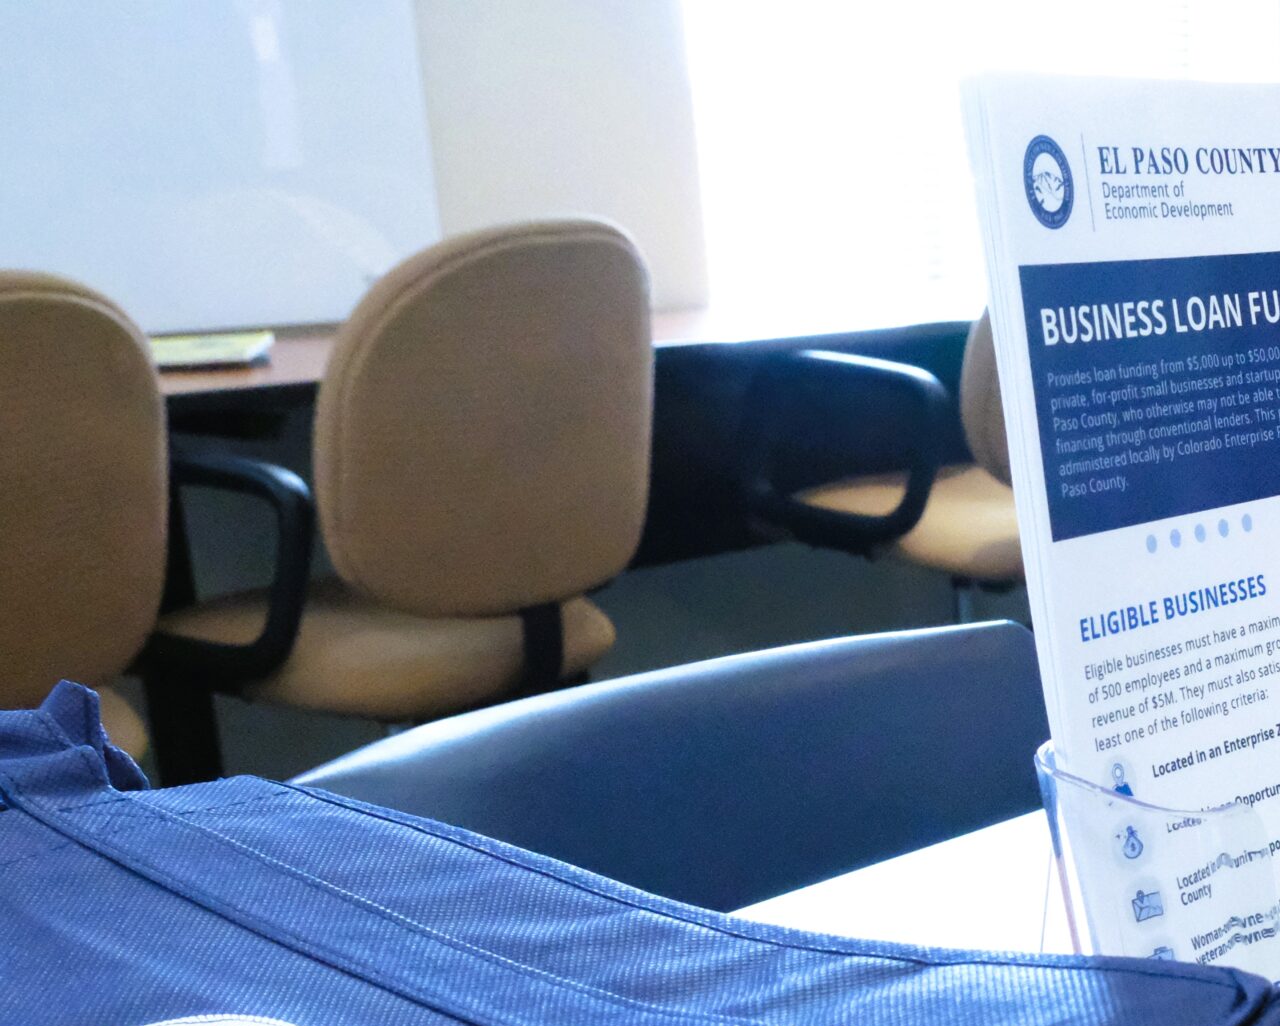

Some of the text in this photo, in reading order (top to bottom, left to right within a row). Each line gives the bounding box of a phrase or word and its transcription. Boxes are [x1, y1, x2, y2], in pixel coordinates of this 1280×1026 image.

[1097, 146, 1280, 174] EL PASO COUNTY
[1101, 180, 1184, 201] Department of
[1104, 200, 1233, 219] Economic Development
[1040, 299, 1167, 345] BUSINESS
[1172, 293, 1242, 332] LOAN
[1047, 369, 1092, 387] Provides
[1093, 366, 1116, 382] loan
[1118, 362, 1159, 379] funding
[1160, 358, 1184, 374] from
[1186, 353, 1219, 371] $5,000
[1221, 355, 1233, 368] up
[1235, 353, 1245, 364] to
[1051, 393, 1089, 412] private,
[1091, 384, 1139, 405] for-profit
[1140, 379, 1168, 398] small
[1169, 376, 1223, 394] businesses
[1226, 370, 1243, 386] and
[1052, 416, 1078, 432] Paso
[1080, 411, 1120, 428] County,
[1122, 406, 1143, 421] who
[1145, 399, 1194, 419] otherwise
[1197, 397, 1217, 413] may
[1220, 394, 1236, 407] not
[1237, 391, 1250, 404] be
[1253, 387, 1273, 402] able
[1056, 435, 1105, 454] financing
[1105, 426, 1146, 447] through
[1148, 415, 1212, 439] conventional
[1213, 412, 1253, 428] lenders.
[1254, 407, 1275, 422] This
[1059, 451, 1127, 476] administered
[1128, 445, 1160, 464] locally
[1162, 444, 1174, 462] by
[1177, 436, 1222, 455] Colorado
[1224, 429, 1274, 447] Enterprise
[1061, 475, 1128, 497] Paso County.
[1080, 574, 1266, 642] ELIGIBLE BUSINESSES
[1084, 657, 1123, 680] Eligible
[1125, 643, 1182, 668] businesses
[1185, 634, 1211, 651] must
[1212, 628, 1237, 643] have
[1240, 626, 1246, 636] a
[1088, 687, 1098, 704] of
[1101, 681, 1122, 700] 500
[1124, 667, 1180, 693] employees
[1183, 658, 1203, 676] and
[1205, 658, 1212, 670] a
[1214, 644, 1263, 666] maximum
[1092, 705, 1135, 728] revenue
[1138, 696, 1148, 713] of
[1151, 690, 1177, 709] $5M.
[1179, 684, 1204, 700] They
[1207, 675, 1233, 692] must
[1235, 669, 1256, 684] also
[1094, 688, 1268, 752] least one of the following criteria:
[1152, 751, 1194, 778] Located
[1195, 750, 1206, 763] in
[1209, 746, 1222, 759] an
[1223, 729, 1274, 753] Enterprise
[1180, 883, 1212, 906] County
